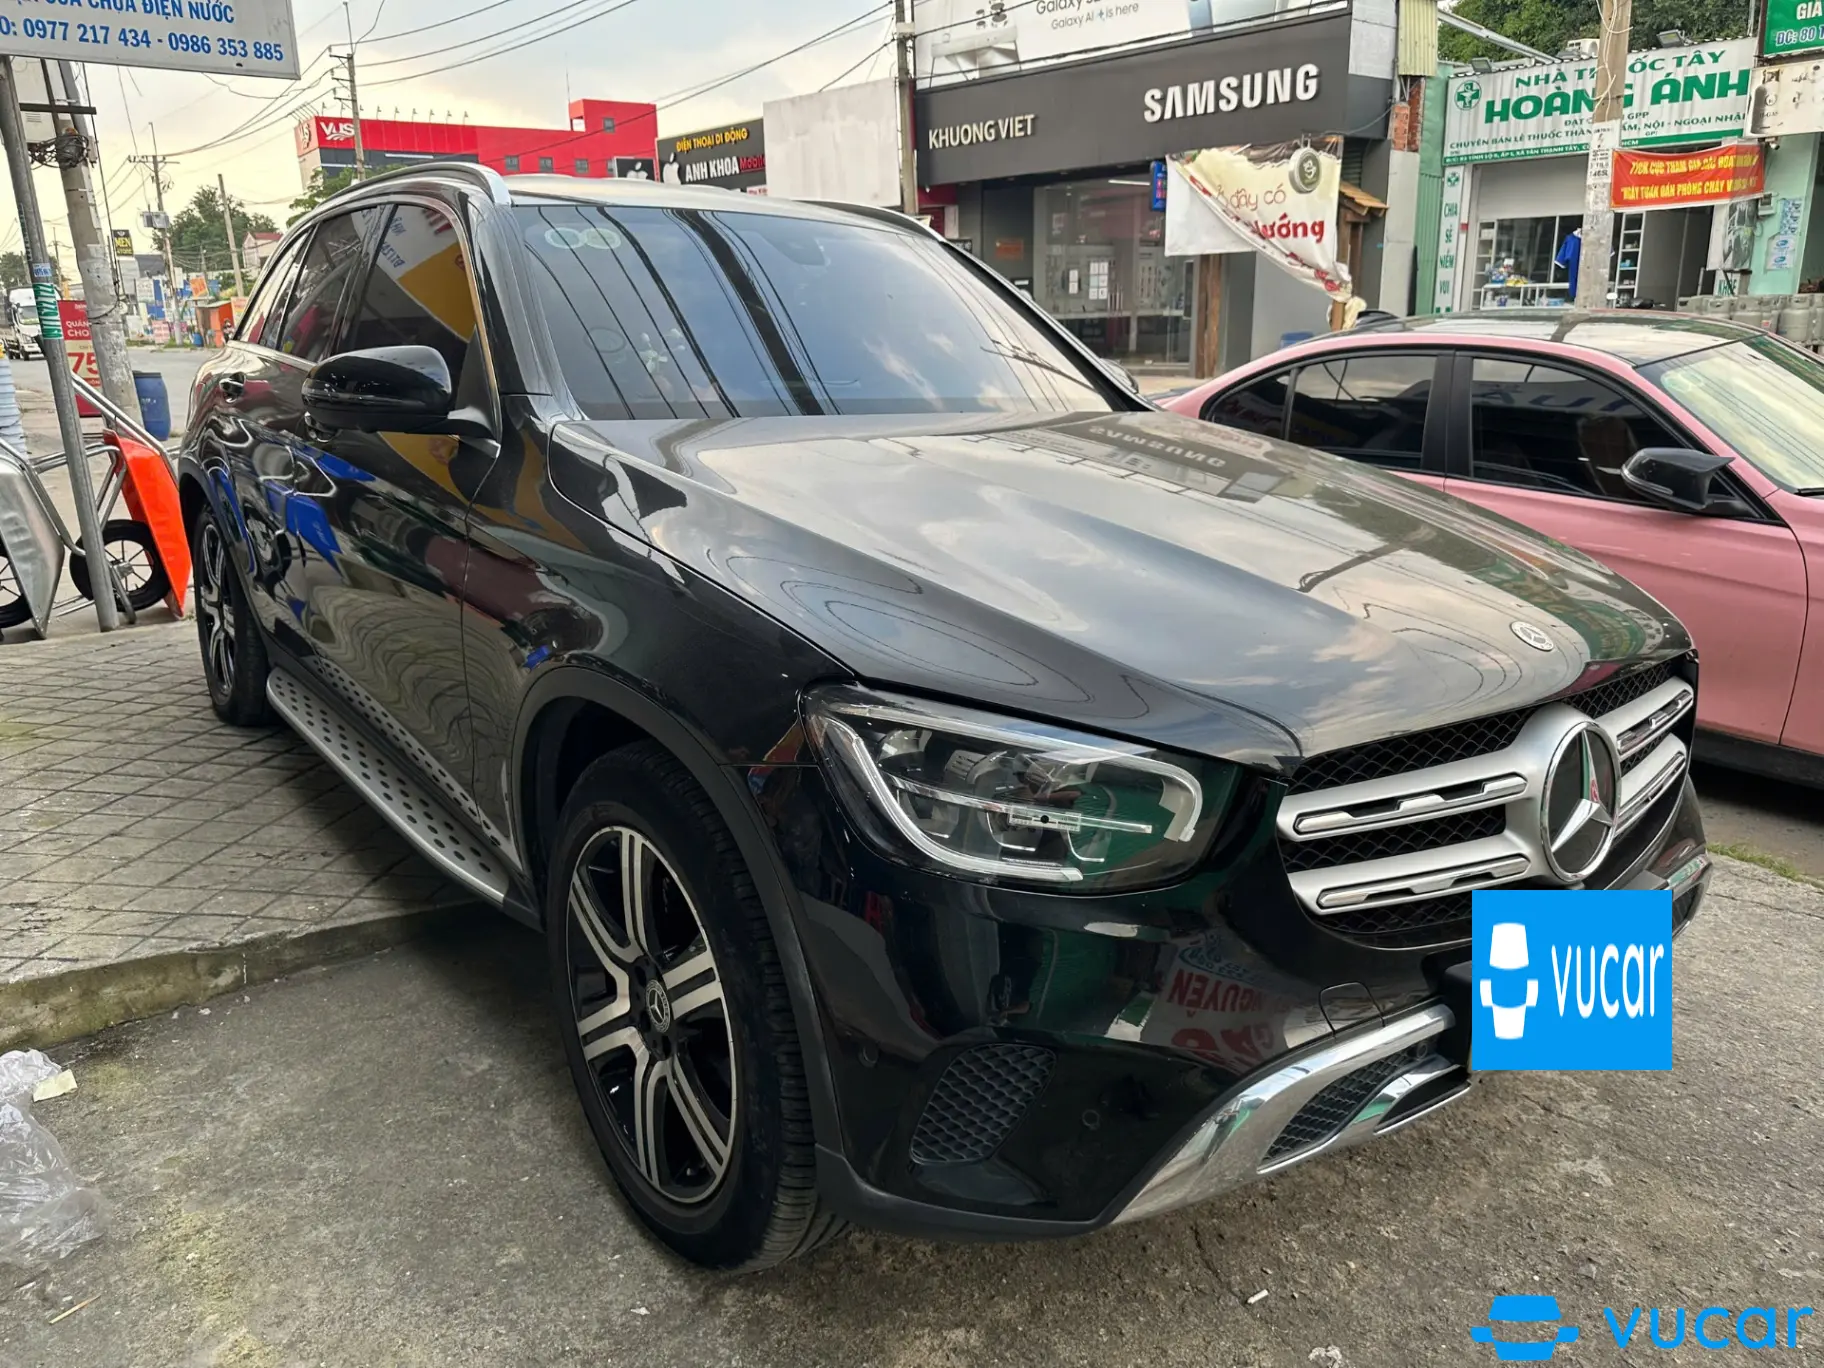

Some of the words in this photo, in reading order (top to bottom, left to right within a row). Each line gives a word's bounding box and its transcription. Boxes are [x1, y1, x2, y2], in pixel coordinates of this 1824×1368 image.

[1051, 14, 1084, 29] Galaxy
[1105, 7, 1114, 18] is
[1116, 3, 1139, 16] here
[23, 18, 69, 41] 0977
[77, 23, 110, 44] 217
[118, 28, 151, 48] 434
[168, 32, 211, 54] 0986
[217, 37, 248, 58] 353
[253, 41, 283, 61] 885
[1516, 68, 1568, 89] NHÀ
[1671, 49, 1726, 68] TÂY
[1143, 63, 1320, 123] SAMSUNG
[1650, 69, 1750, 106] ÁNH
[928, 118, 996, 149] KHUONG
[997, 114, 1035, 140] VIET
[1674, 115, 1712, 128] NGOẠI
[686, 161, 708, 183] ANH
[709, 156, 740, 179] KHOA
[1264, 182, 1287, 204] có
